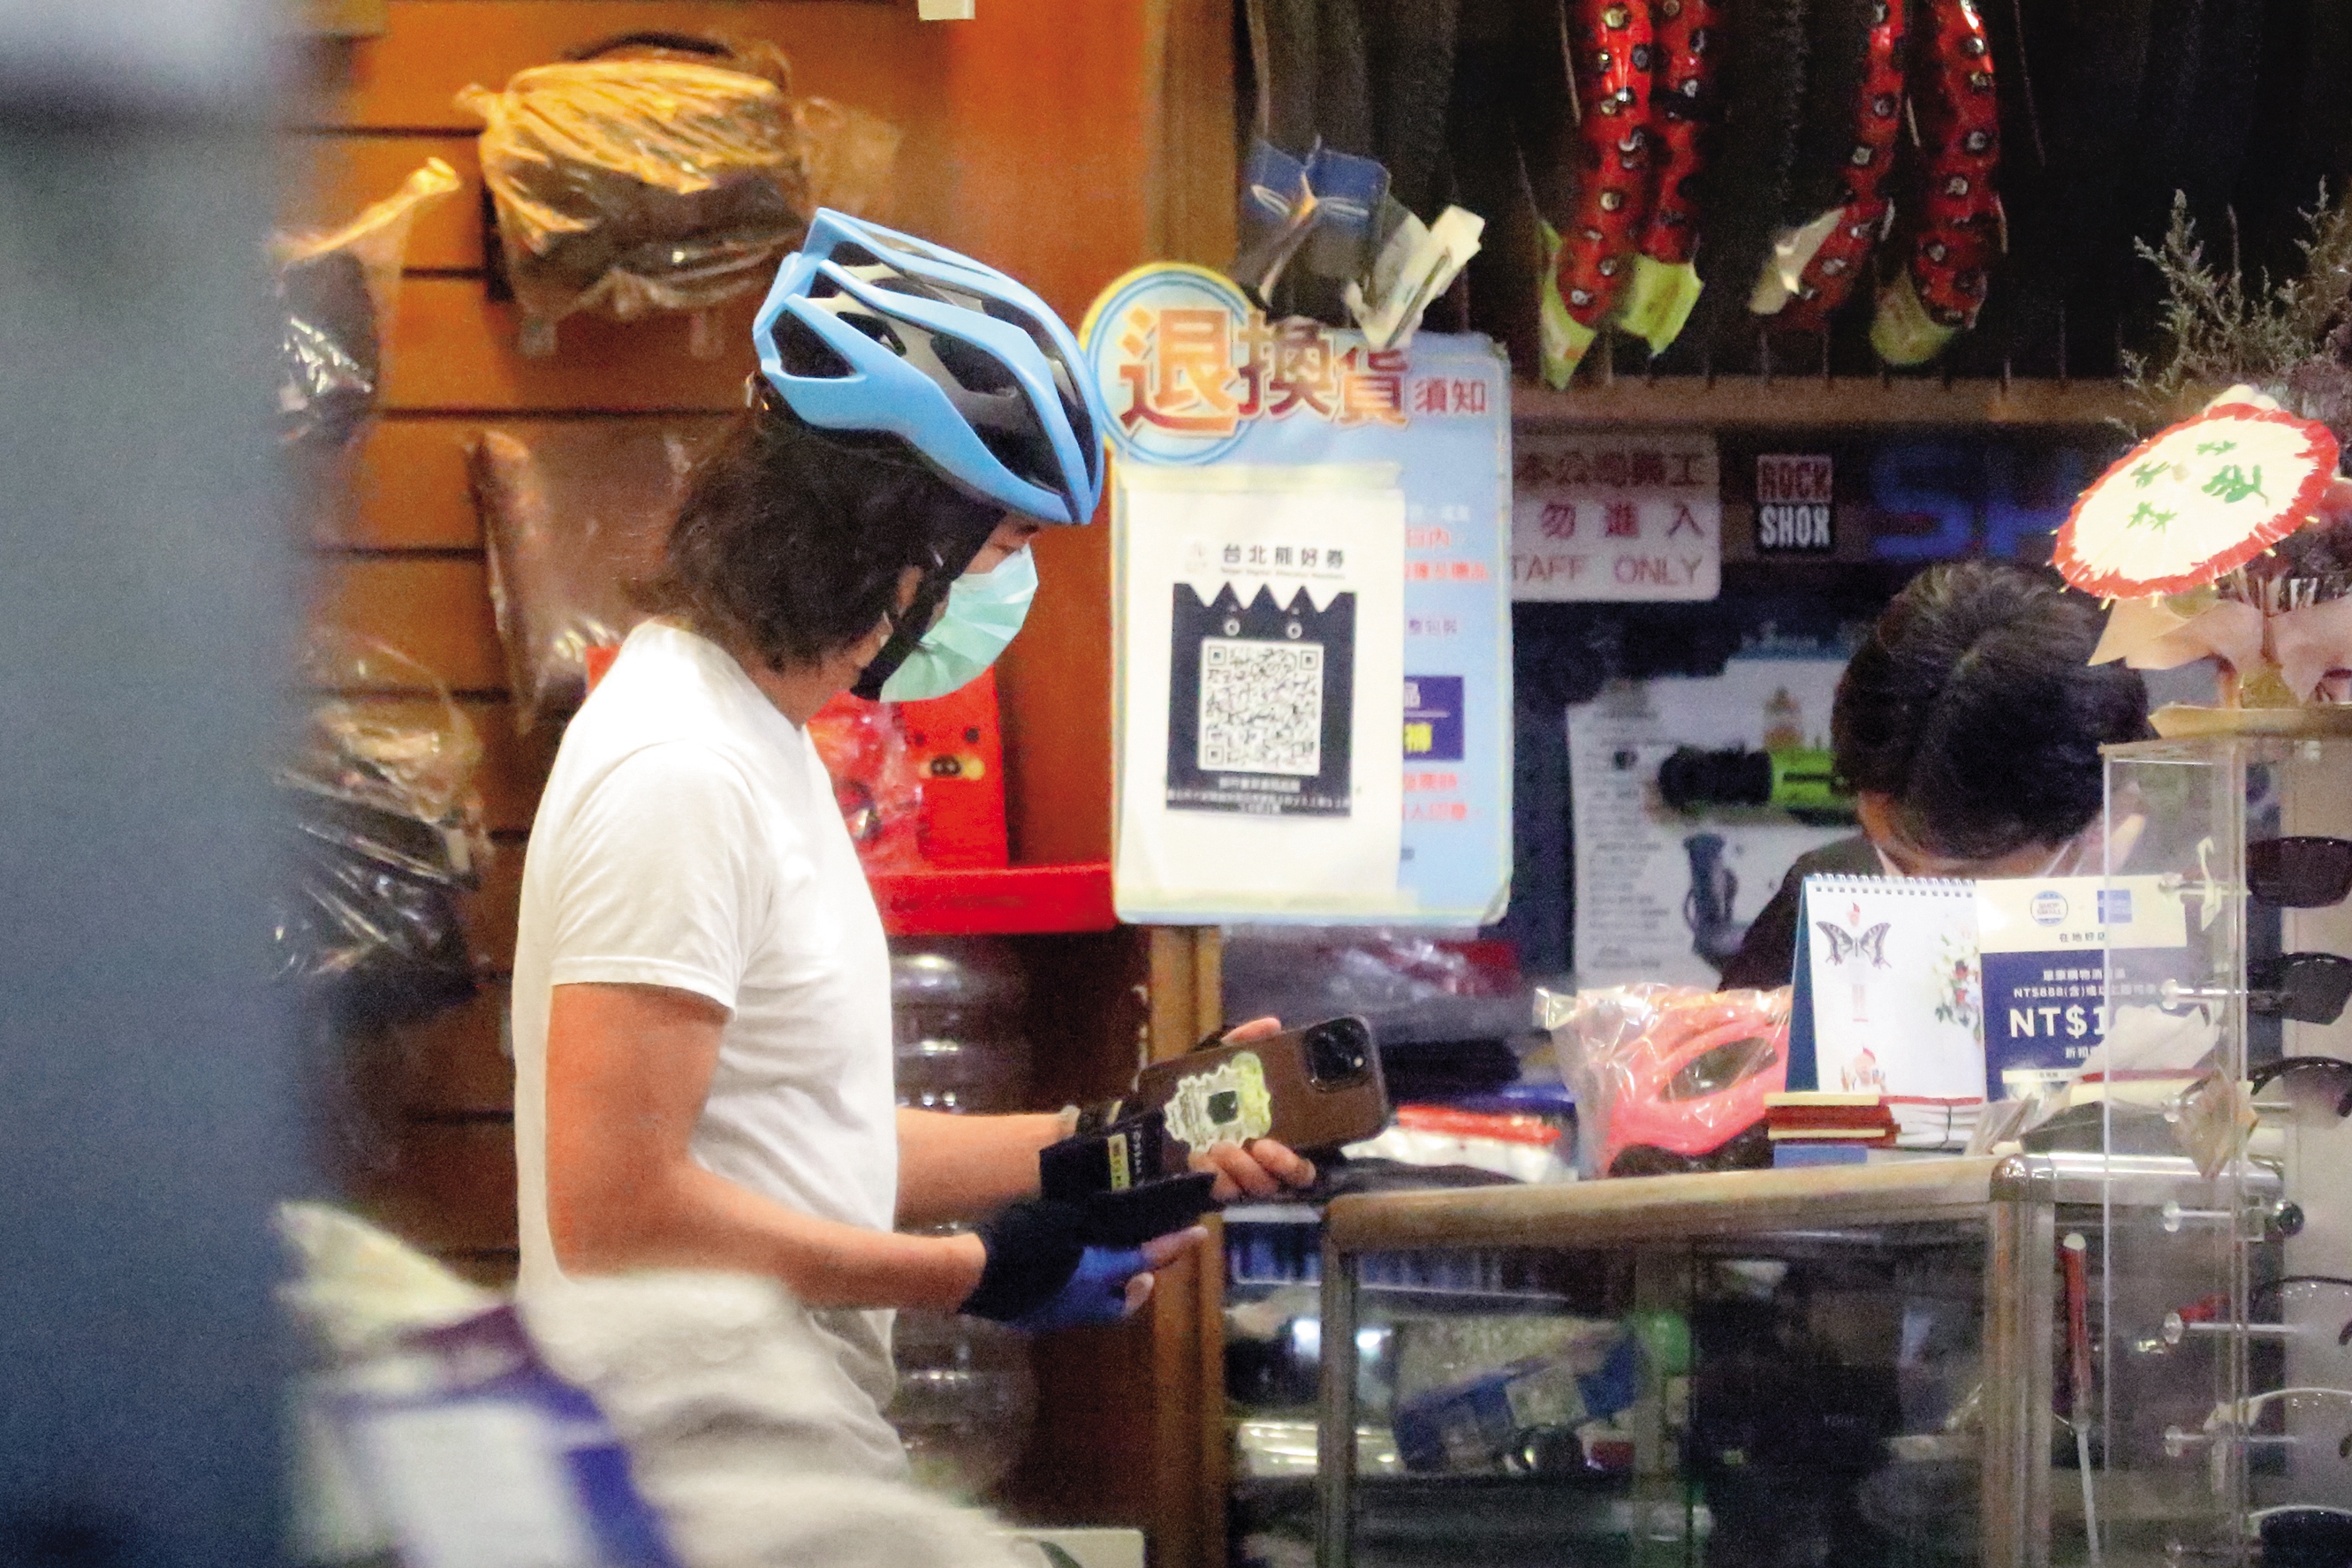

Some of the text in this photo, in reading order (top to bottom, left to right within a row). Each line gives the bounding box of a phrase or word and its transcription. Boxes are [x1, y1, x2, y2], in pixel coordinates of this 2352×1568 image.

[1761, 460, 1829, 500] ROCK
[1759, 504, 1831, 548] SHOX
[1613, 554, 1703, 587] ONLY
